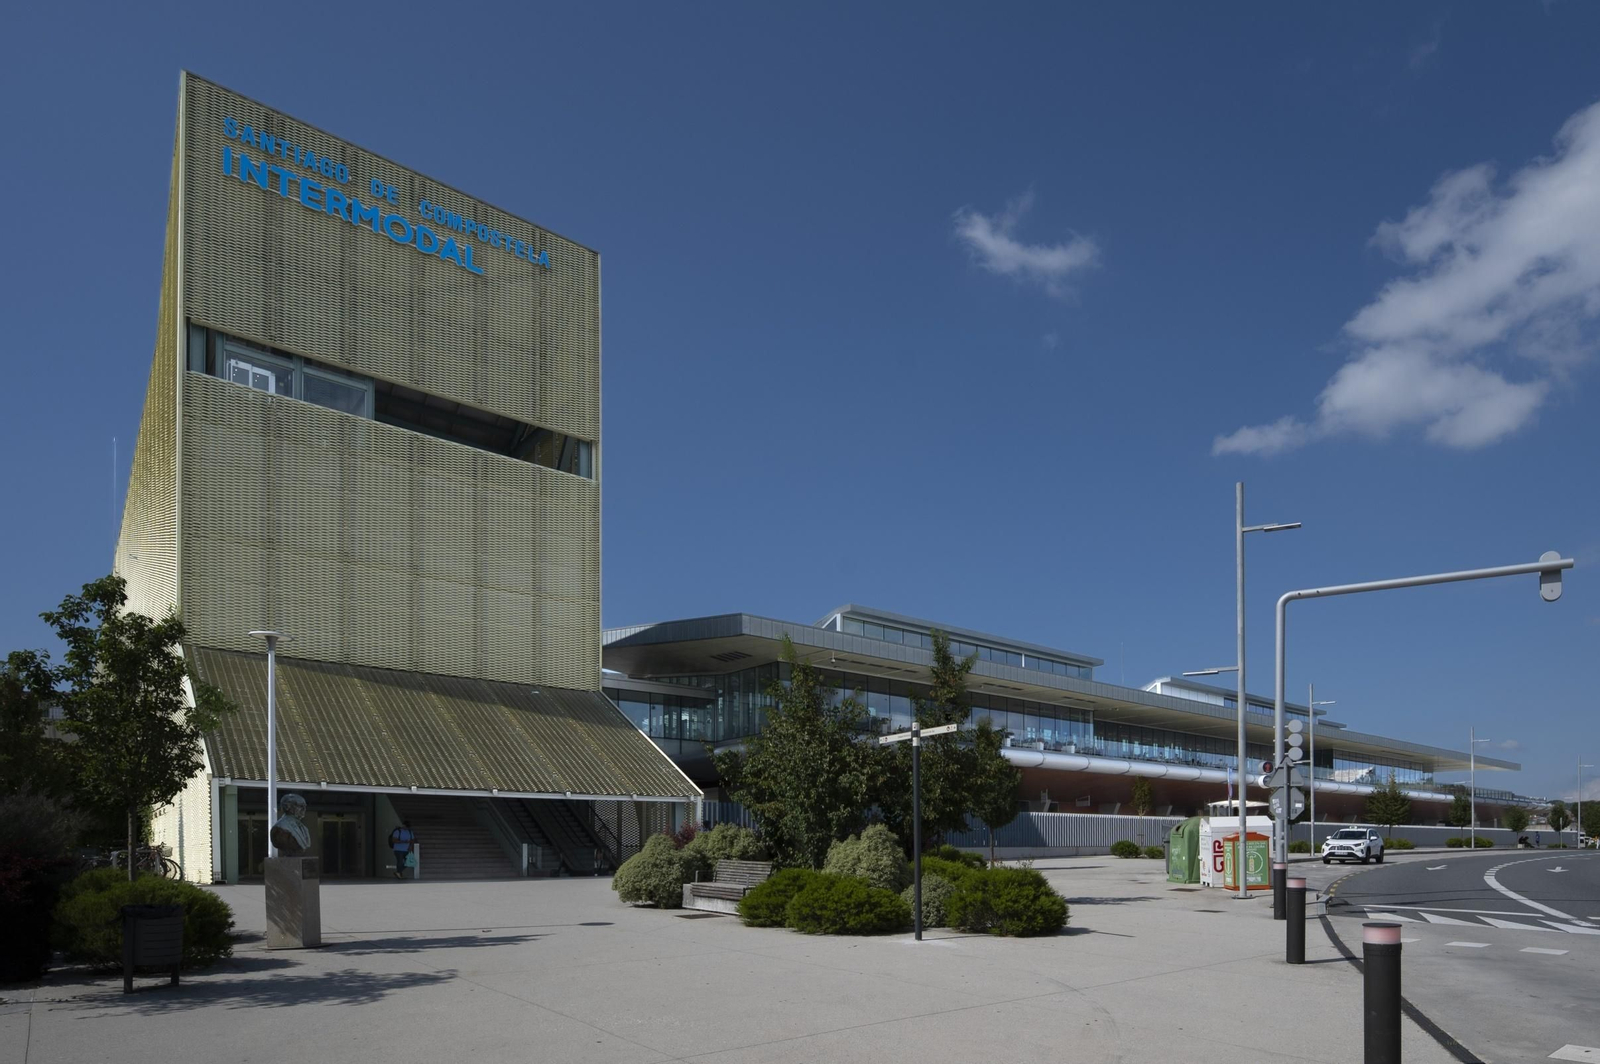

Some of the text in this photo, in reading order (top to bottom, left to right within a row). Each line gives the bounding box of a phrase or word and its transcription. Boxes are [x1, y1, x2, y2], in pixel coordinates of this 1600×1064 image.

[223, 116, 550, 269] SANTIAGO DE COMPOSTELA
[223, 146, 485, 275] INTERMODAL
